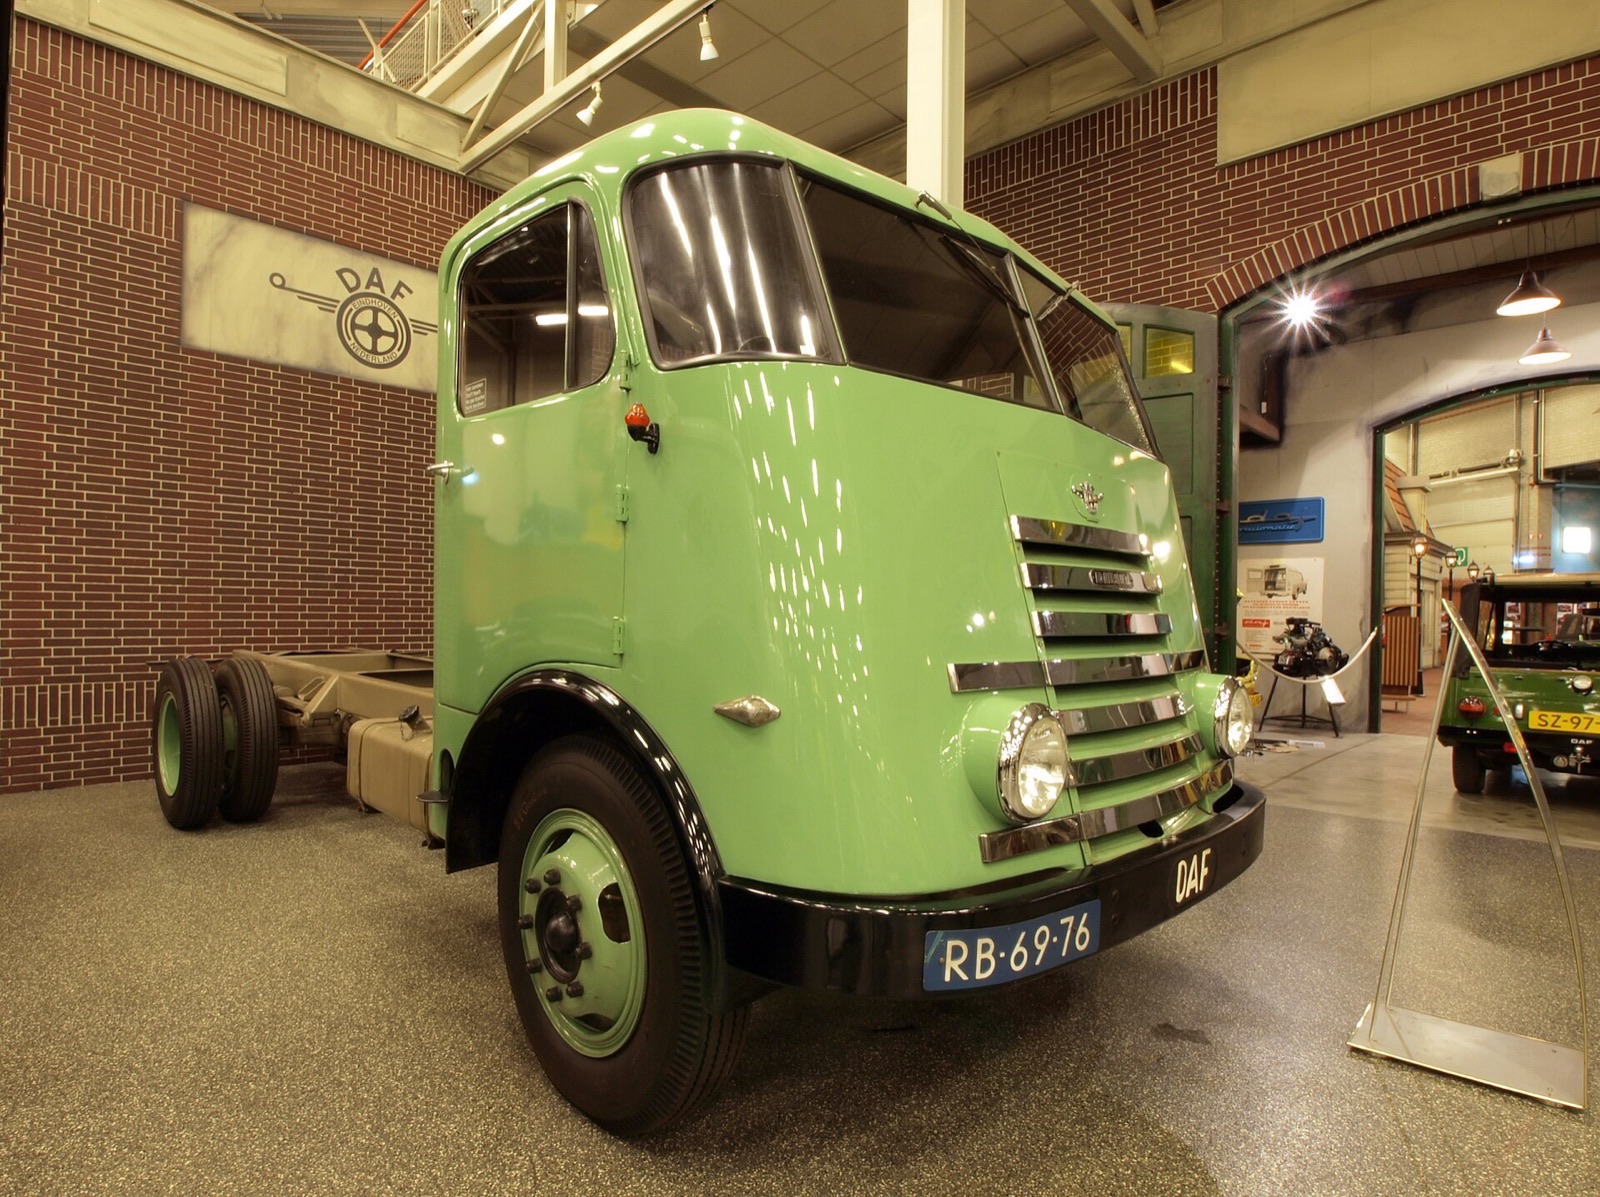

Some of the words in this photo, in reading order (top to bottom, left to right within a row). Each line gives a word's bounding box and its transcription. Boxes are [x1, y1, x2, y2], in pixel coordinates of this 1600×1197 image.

[335, 267, 414, 301] DAF
[352, 298, 398, 319] EINDHOVEN
[350, 342, 398, 363] NEDERLAND
[1176, 848, 1211, 903] DAF
